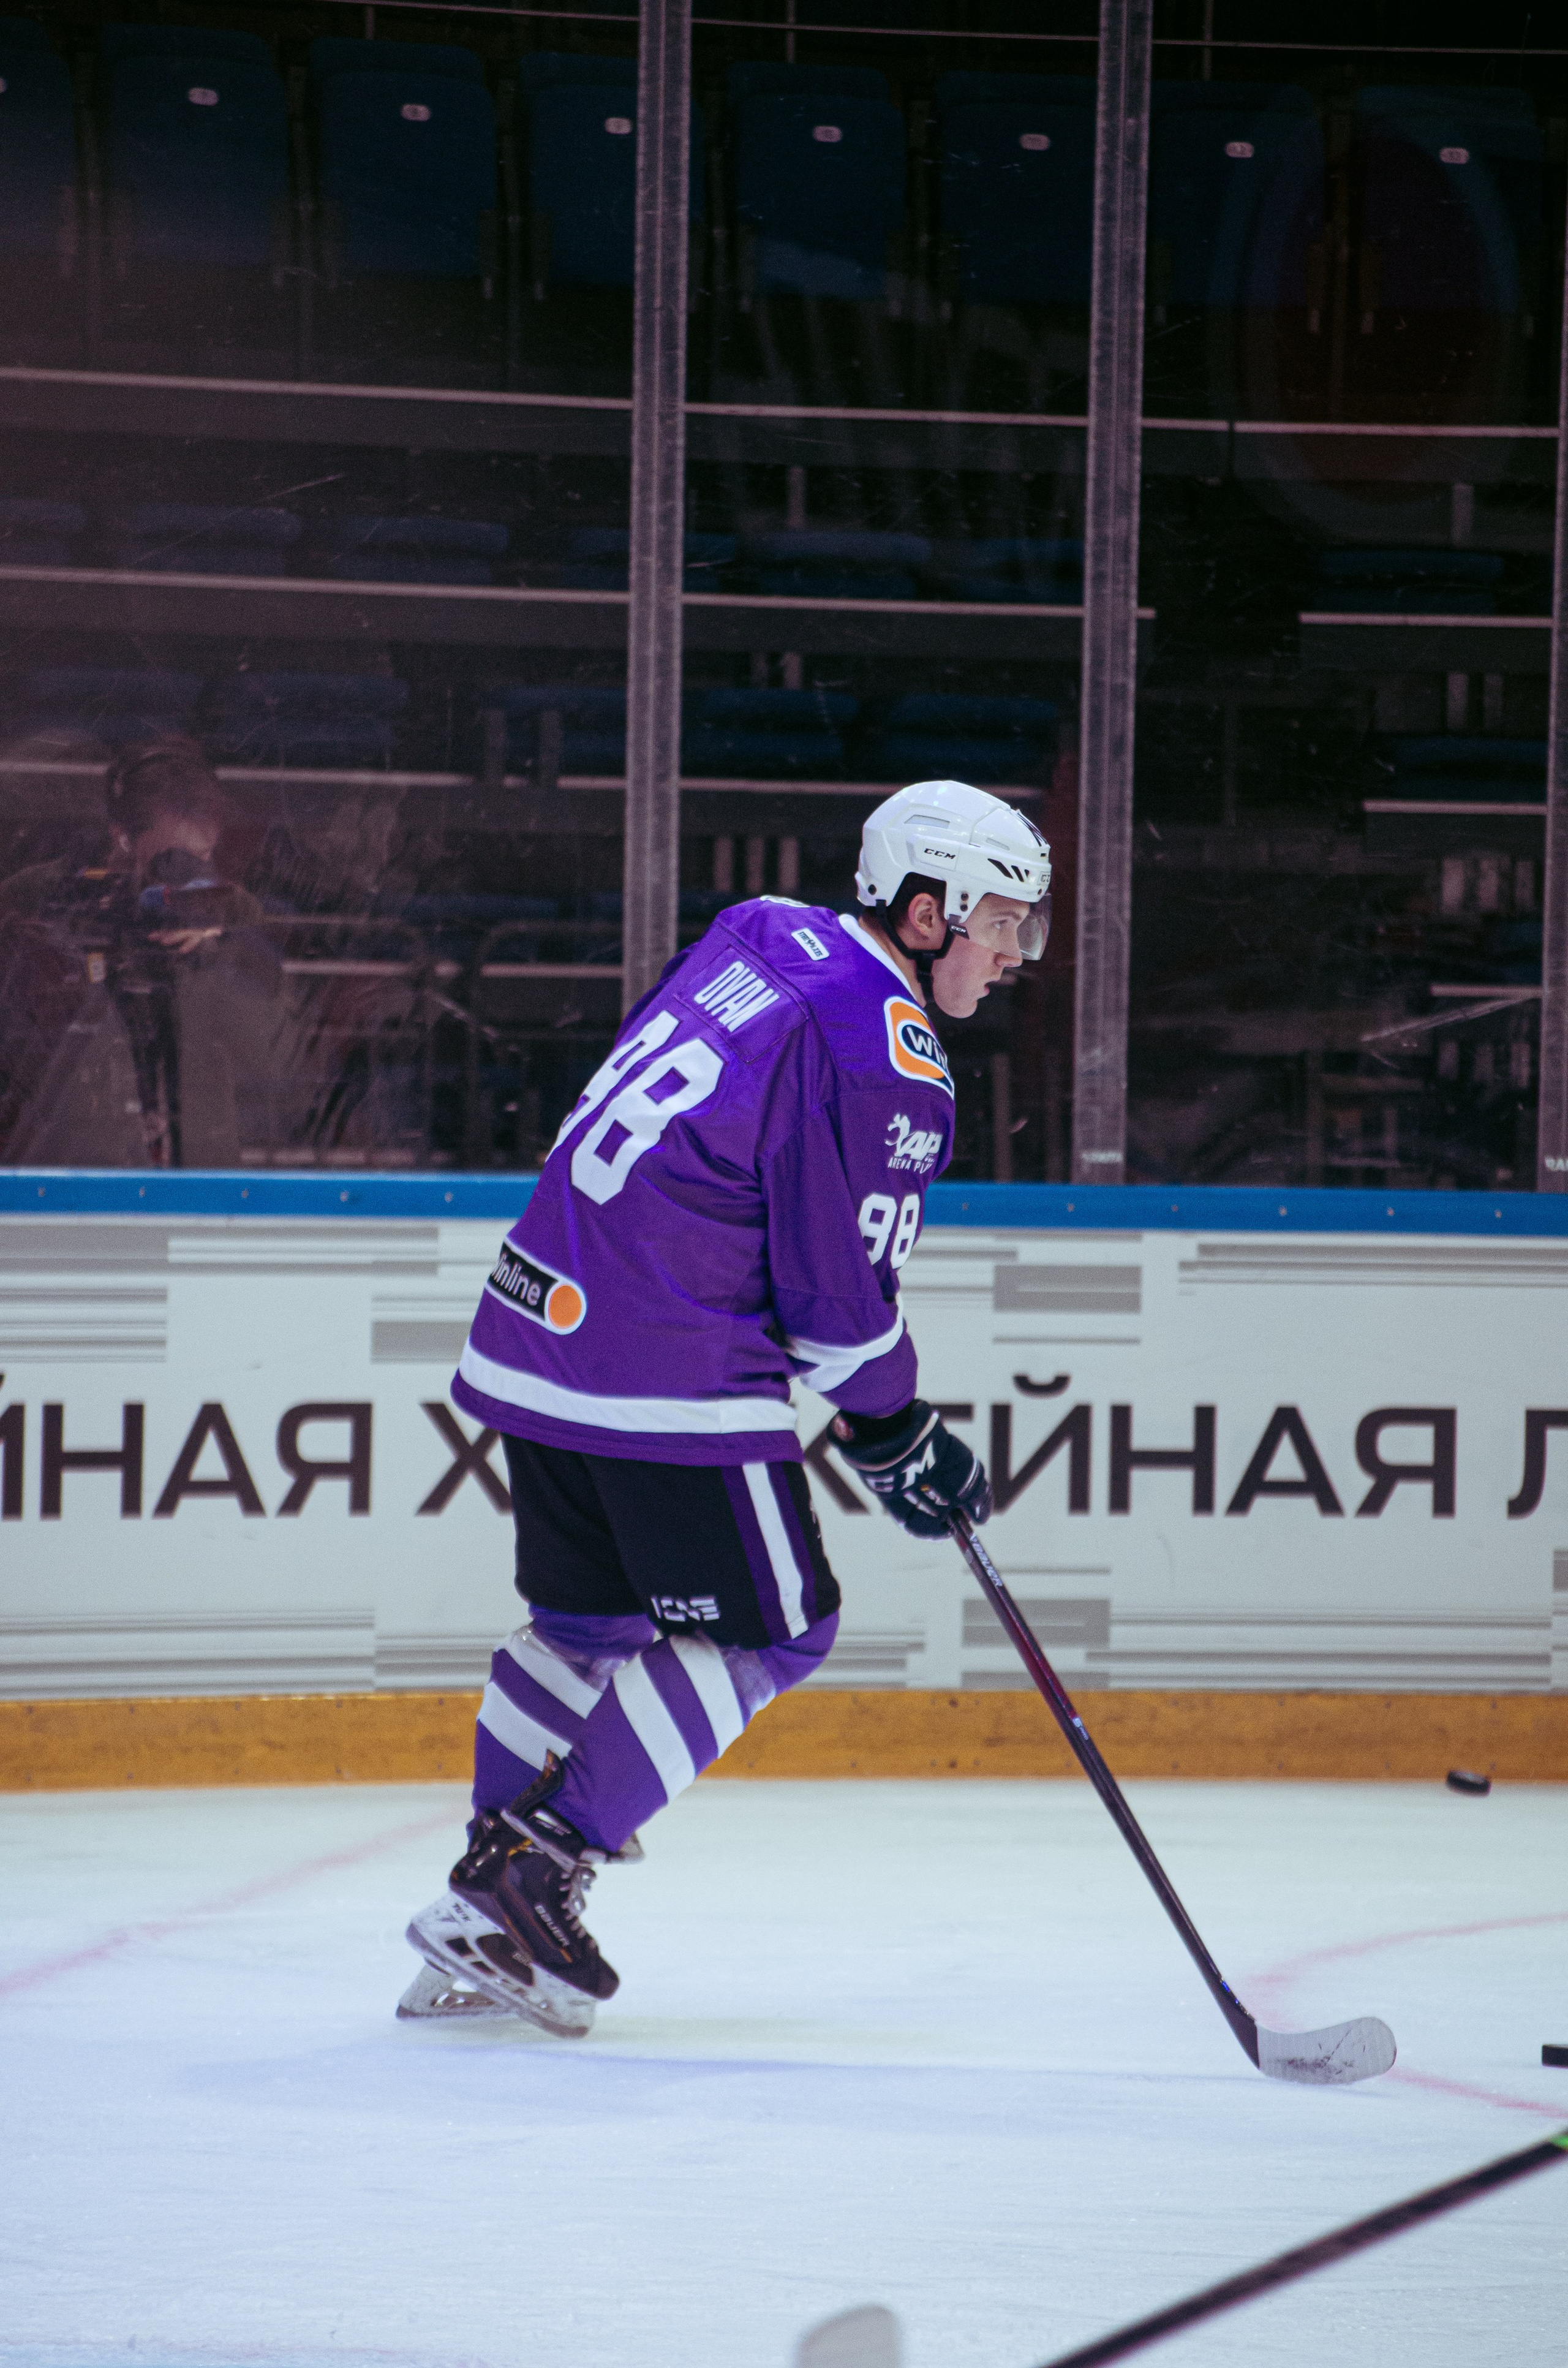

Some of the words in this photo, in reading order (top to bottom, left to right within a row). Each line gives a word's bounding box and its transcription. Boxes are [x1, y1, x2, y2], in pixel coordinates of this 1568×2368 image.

[924, 848, 957, 860] CCM
[545, 1009, 725, 1206] 98
[887, 1157, 912, 1170] ARENA
[858, 1193, 921, 1270] 98
